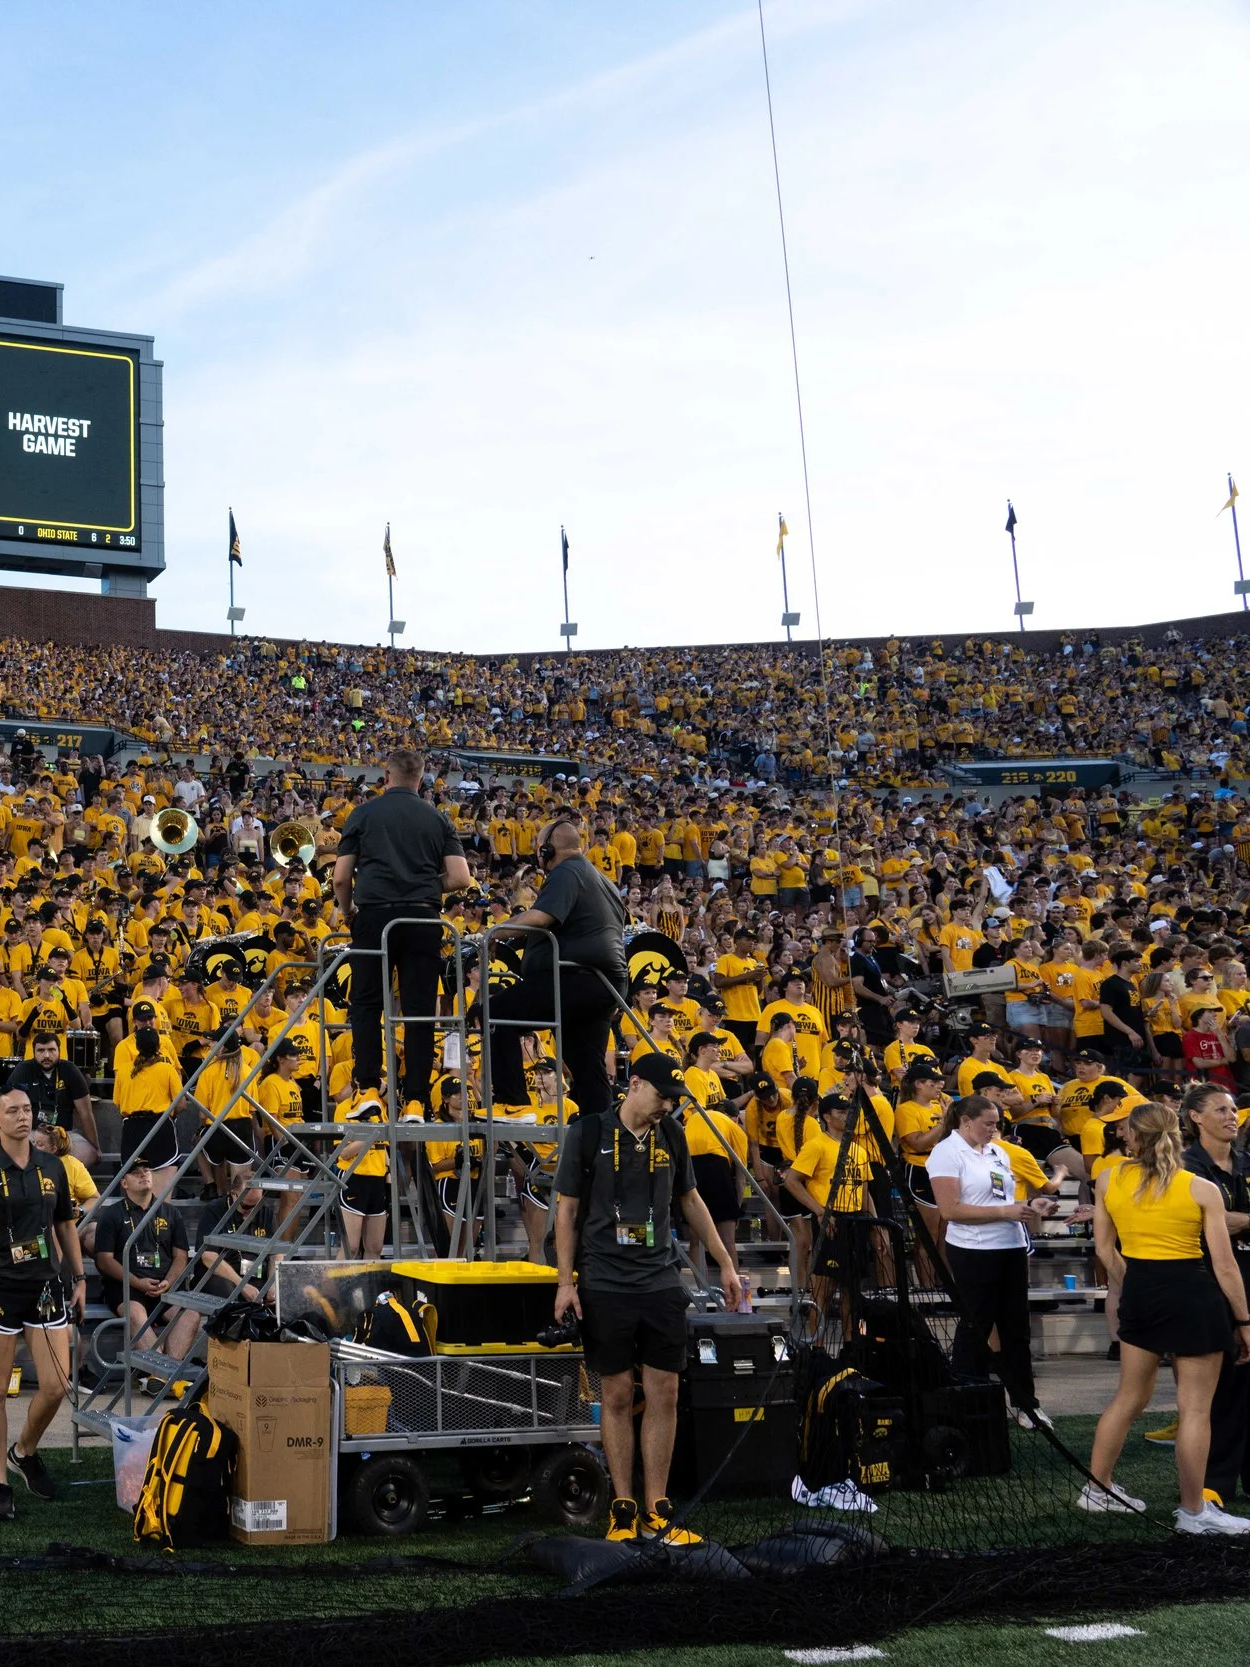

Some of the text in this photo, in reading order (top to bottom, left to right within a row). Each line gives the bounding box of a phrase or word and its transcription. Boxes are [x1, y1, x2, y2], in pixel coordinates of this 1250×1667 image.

[8, 411, 91, 438] HARVEST
[22, 434, 76, 457] GAME
[18, 525, 25, 536] 0
[37, 528, 56, 538] OHIO
[57, 530, 78, 541] STATE
[91, 533, 97, 542] 6
[105, 534, 111, 543] 2
[119, 535, 136, 546] 3:50
[56, 734, 82, 748] 217
[1046, 771, 1077, 783] 220
[602, 856, 612, 872] 3
[37, 1019, 62, 1029] IOWA
[177, 1018, 200, 1031] IOWA
[673, 1018, 692, 1027] OWA
[799, 1021, 819, 1031] OWA
[1065, 1094, 1093, 1104] IOWA
[264, 1422, 269, 1431] 9
[286, 1437, 324, 1448] DMR-9
